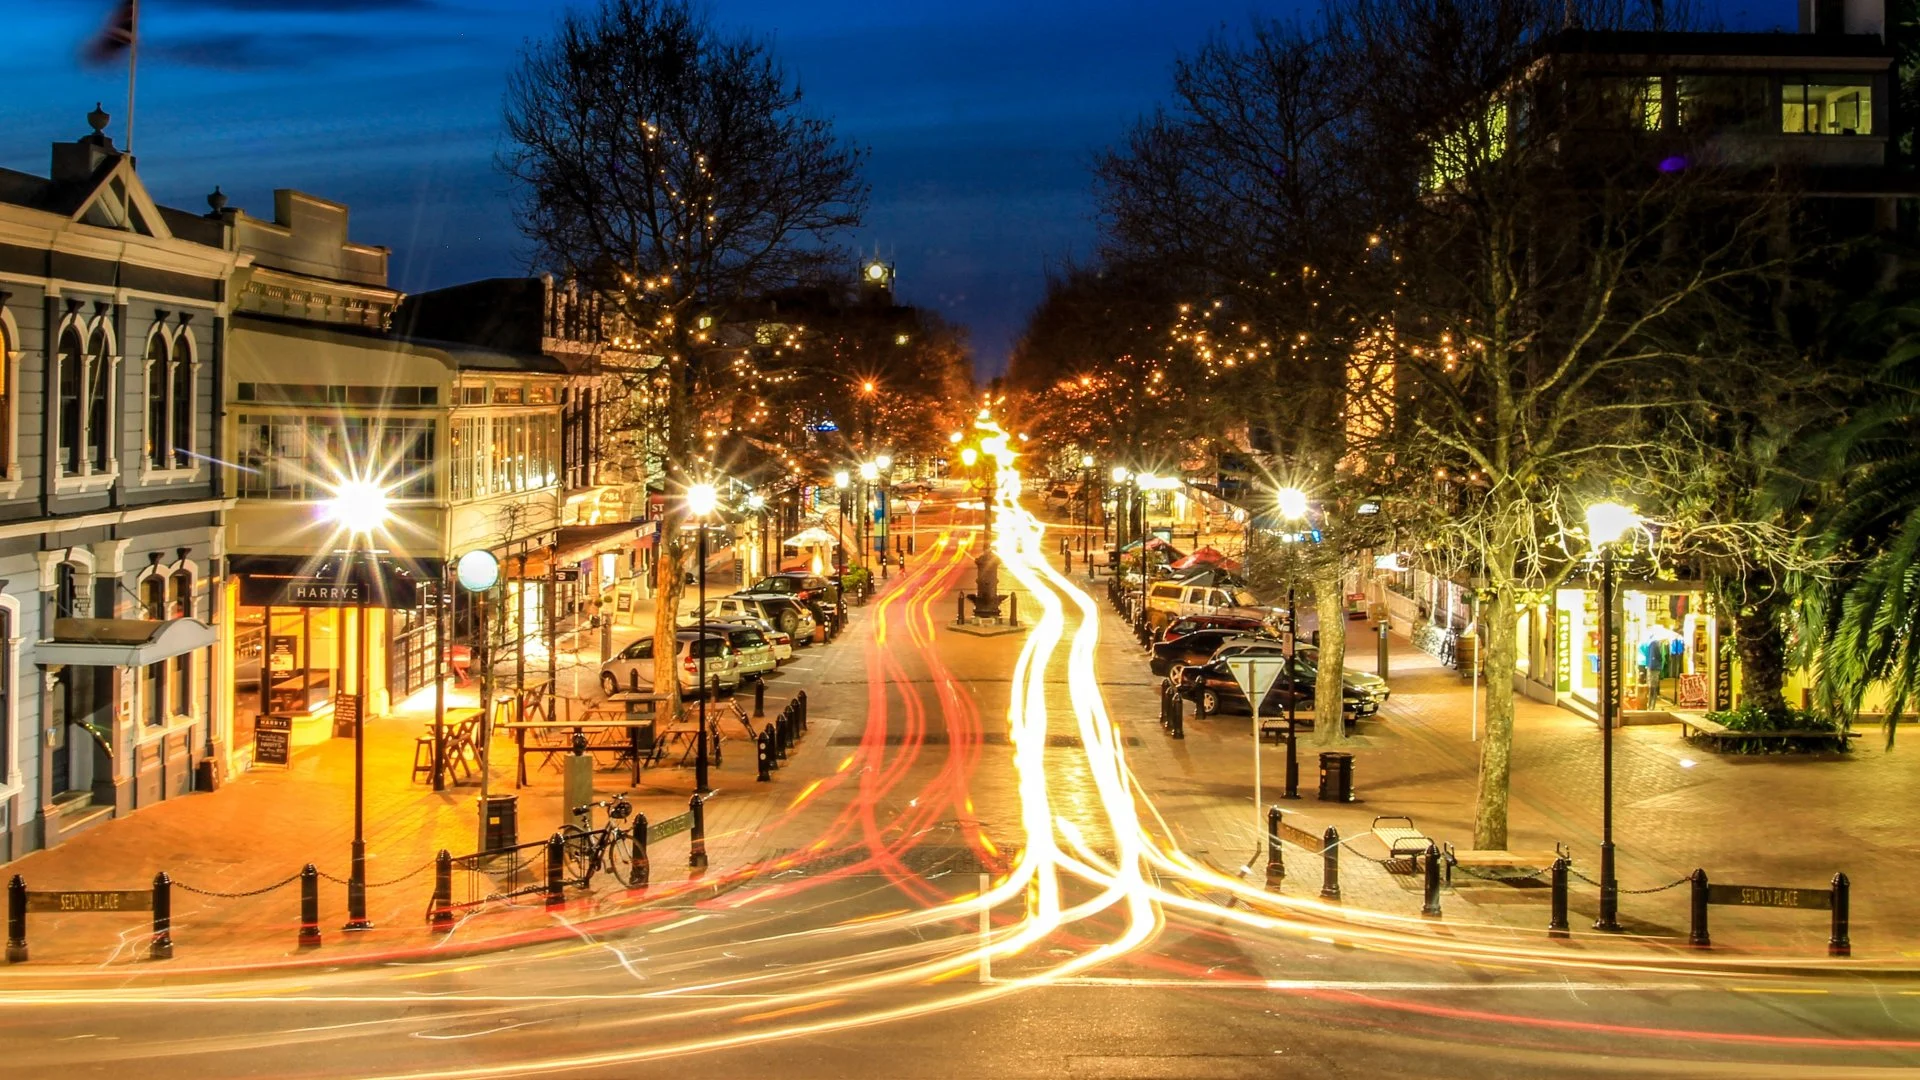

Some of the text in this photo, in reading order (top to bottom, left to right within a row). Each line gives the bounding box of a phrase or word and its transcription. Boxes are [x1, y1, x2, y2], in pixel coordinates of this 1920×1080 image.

[297, 587, 358, 599] HARRYS
[60, 893, 119, 910] SELWYN PLACE
[1773, 889, 1799, 906] PLACE
